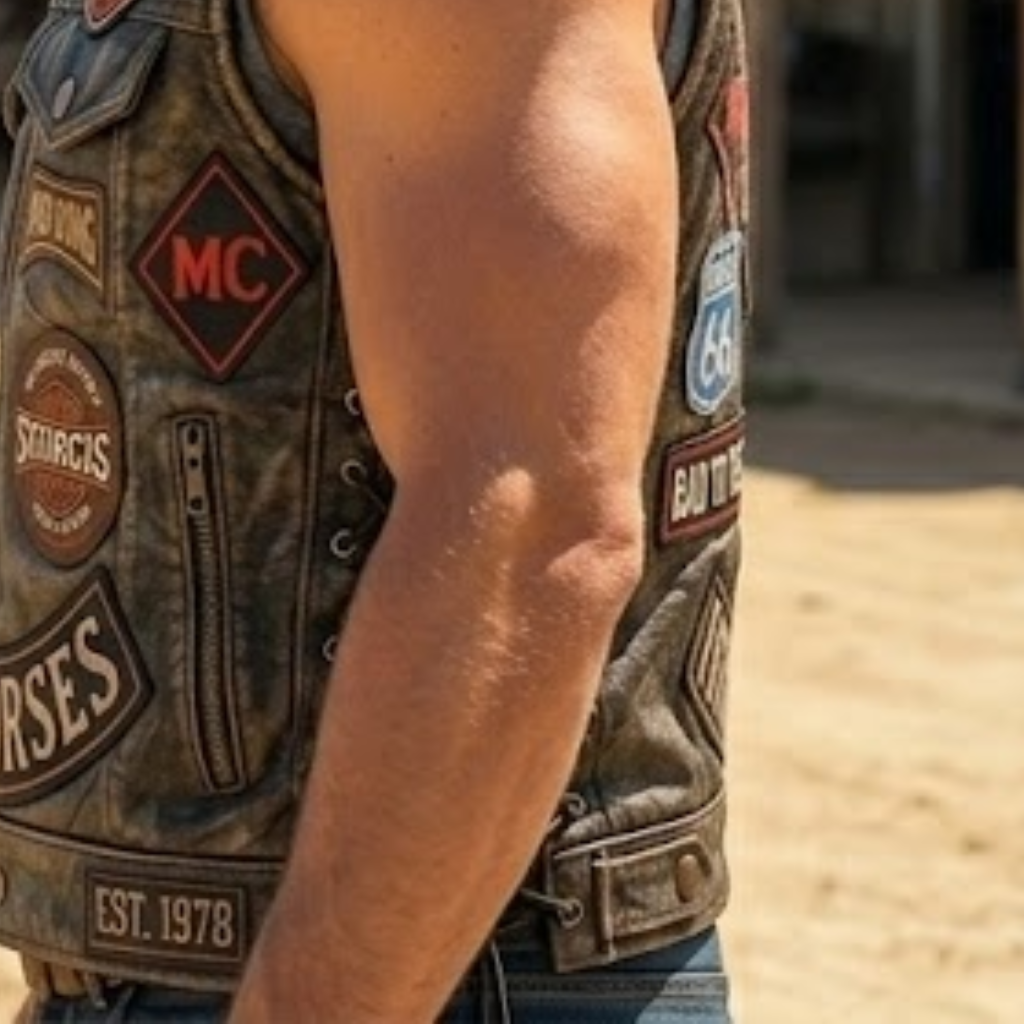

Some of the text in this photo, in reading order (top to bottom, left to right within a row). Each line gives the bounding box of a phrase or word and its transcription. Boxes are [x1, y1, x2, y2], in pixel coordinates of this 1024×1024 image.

[171, 234, 268, 303] MC
[699, 305, 733, 387] 66
[93, 887, 234, 948] EST. 1978
